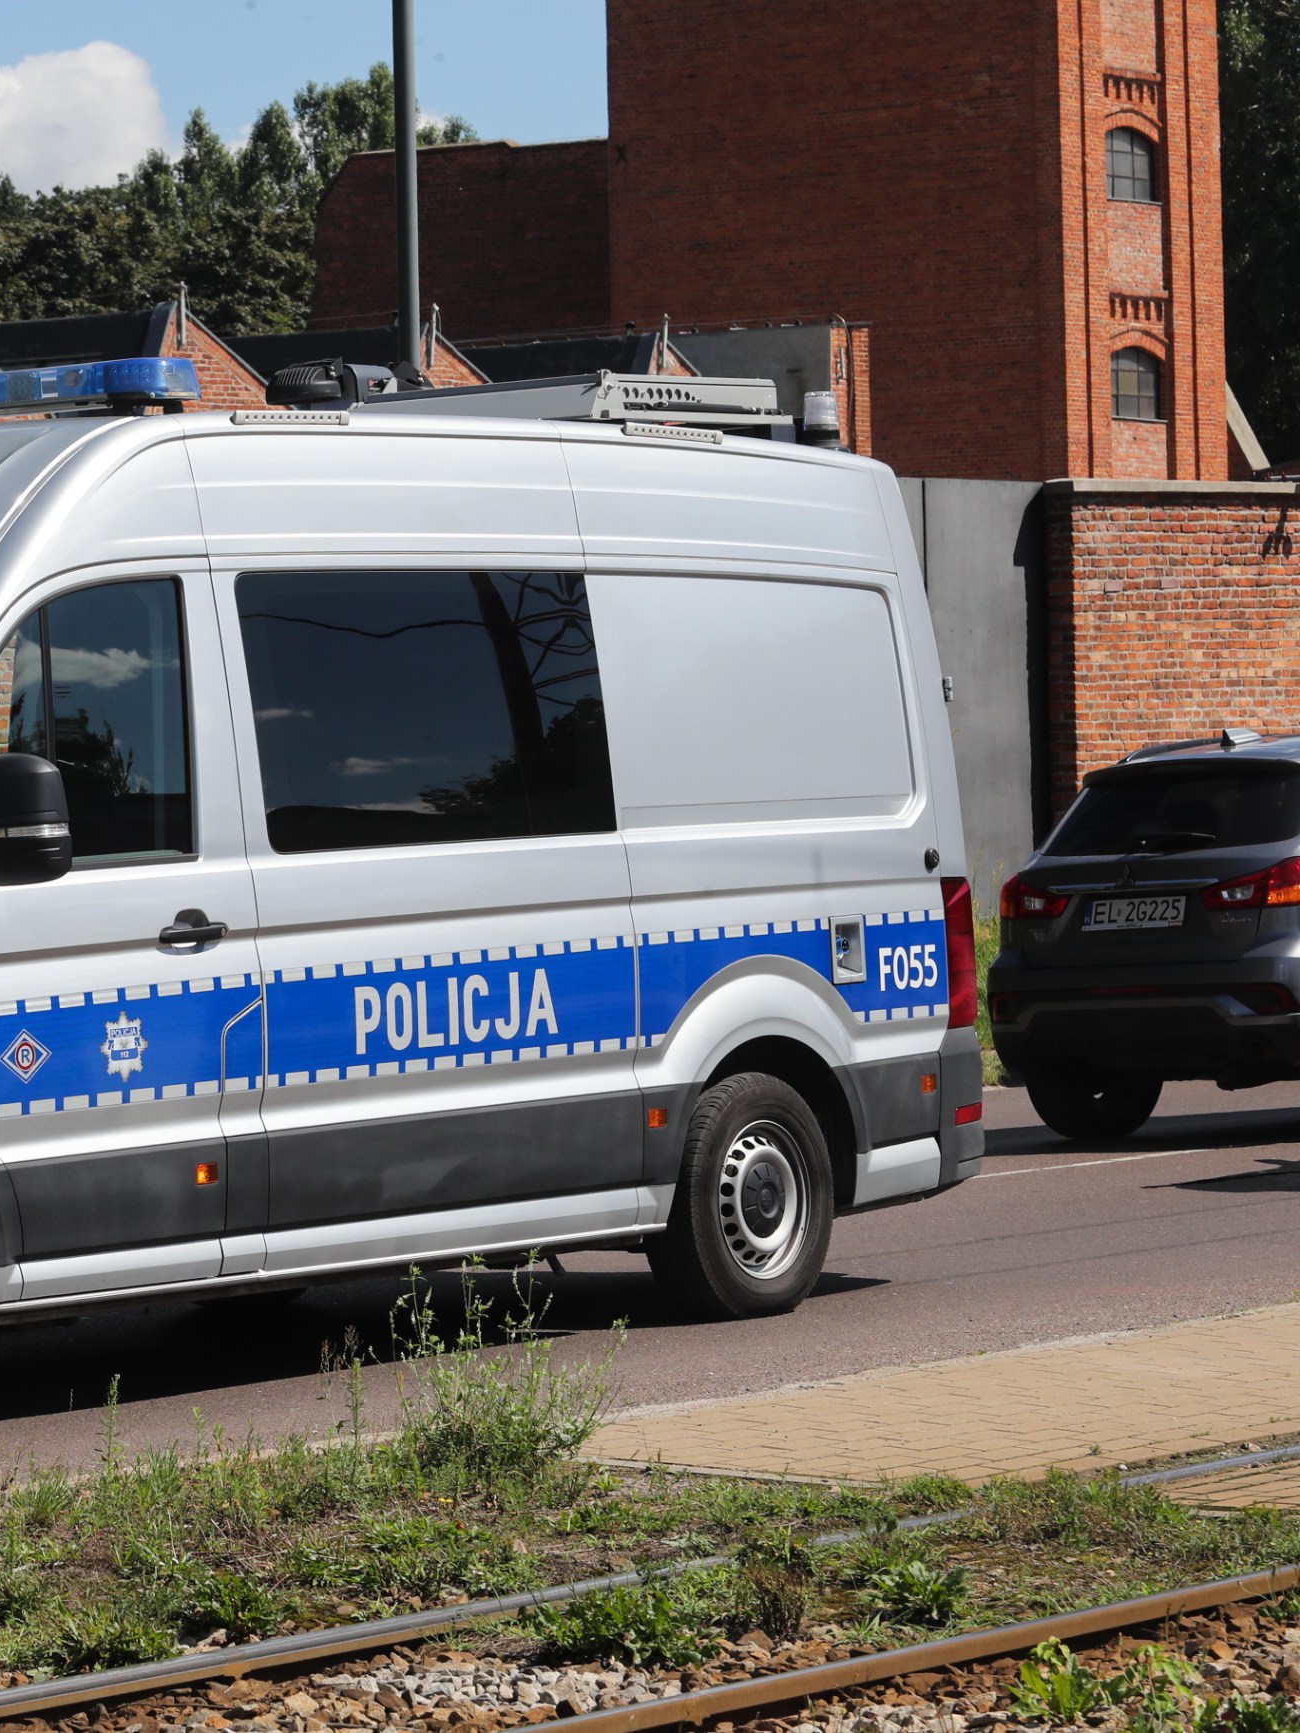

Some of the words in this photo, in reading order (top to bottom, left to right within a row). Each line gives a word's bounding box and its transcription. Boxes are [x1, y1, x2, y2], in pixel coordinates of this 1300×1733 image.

[1093, 902, 1117, 925] EL
[1125, 898, 1182, 923] 2G225
[878, 943, 938, 992] F055
[354, 968, 559, 1056] POLICJA
[110, 1027, 138, 1038] POLICJA
[20, 1048, 32, 1064] R
[120, 1051, 130, 1059] 112
